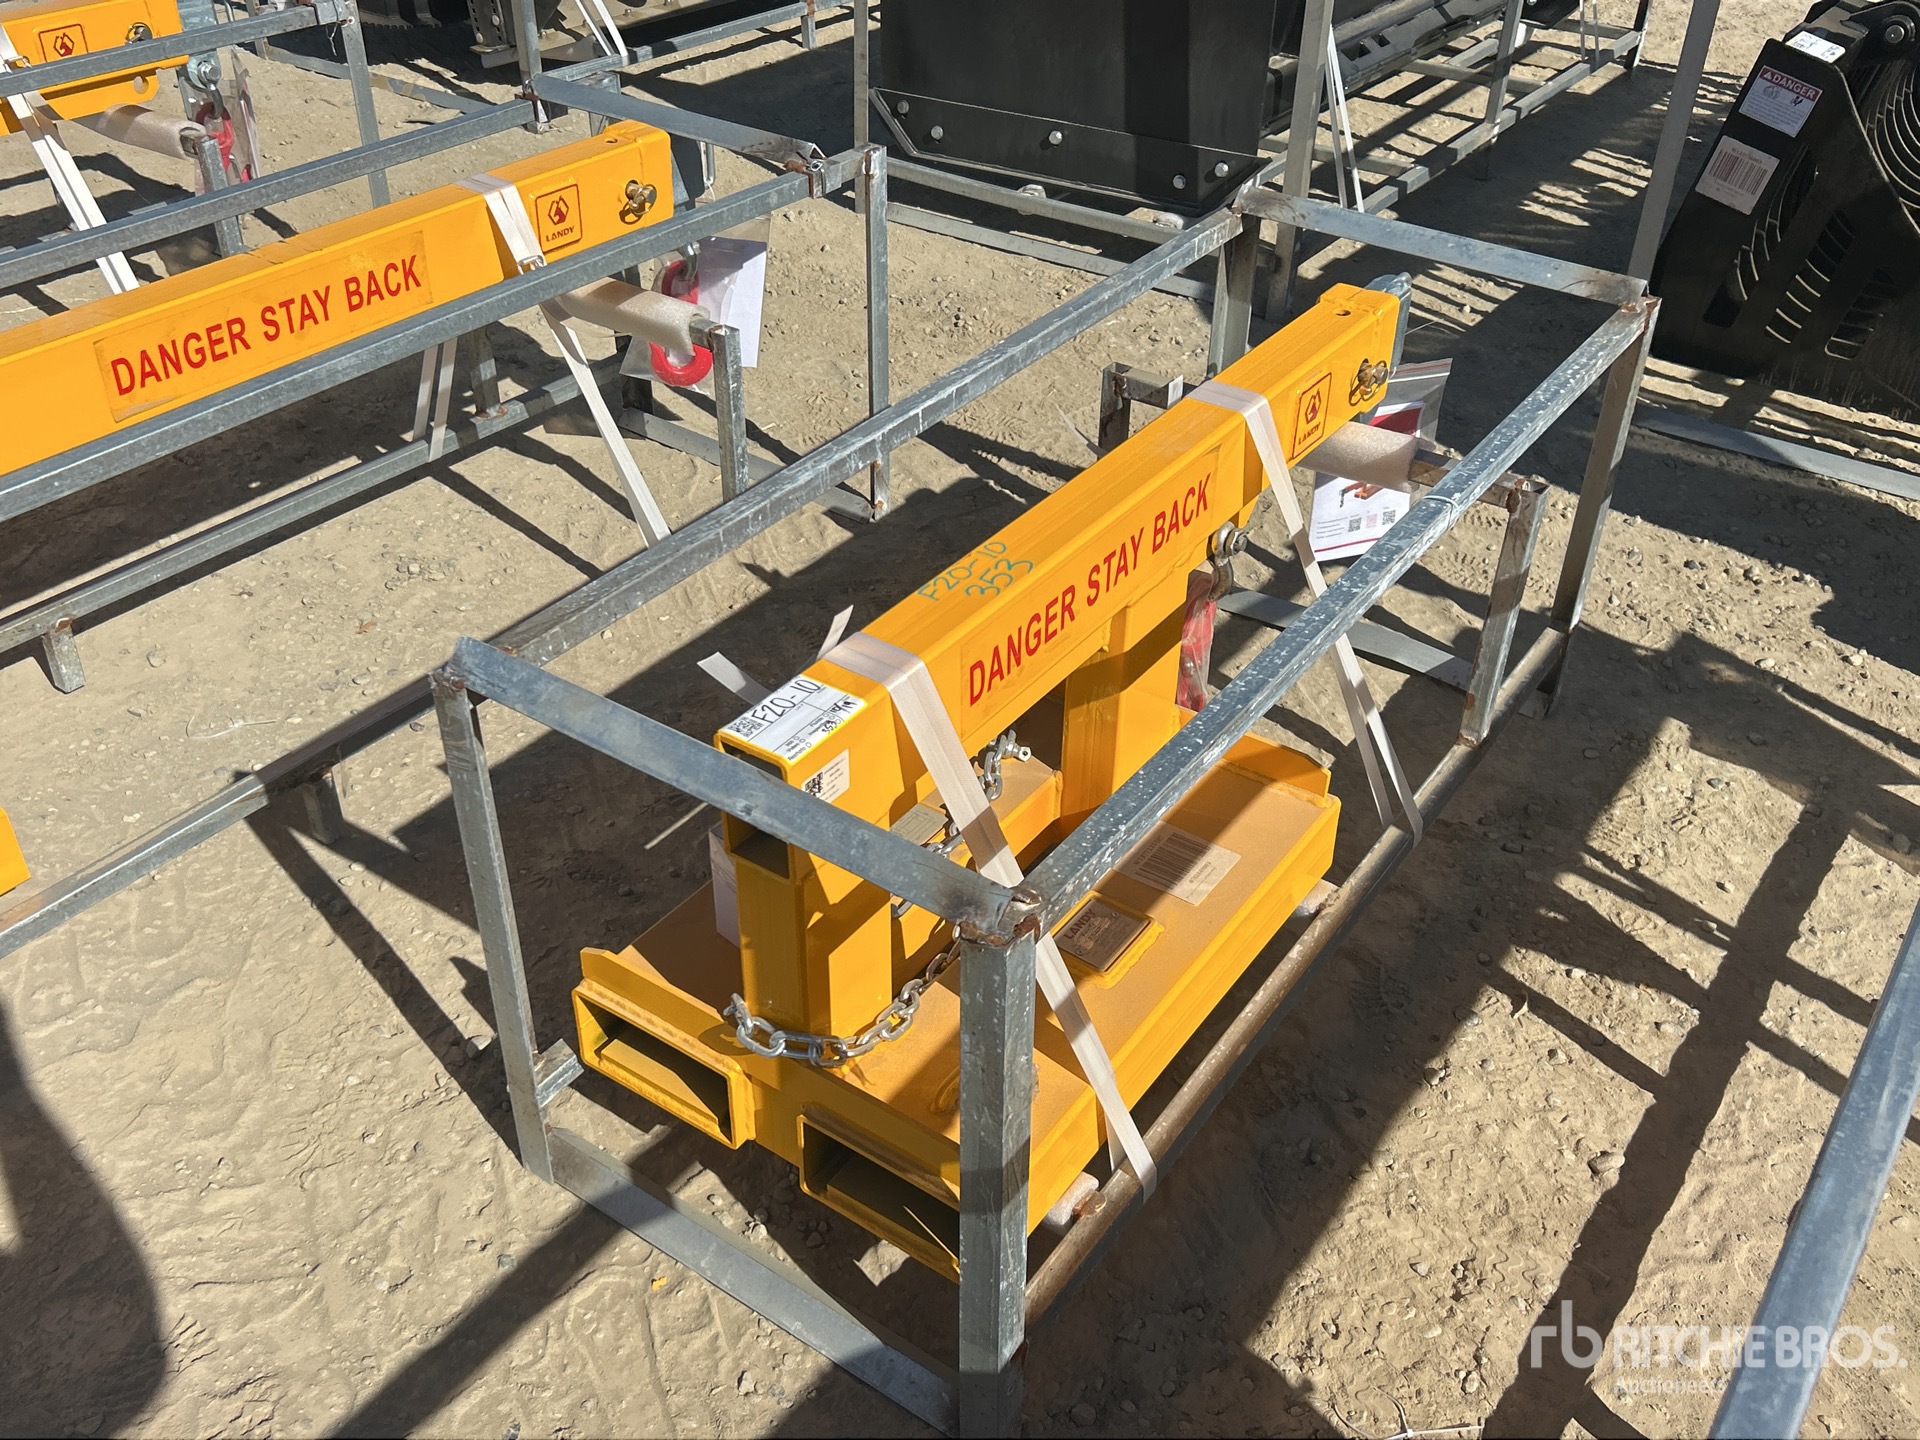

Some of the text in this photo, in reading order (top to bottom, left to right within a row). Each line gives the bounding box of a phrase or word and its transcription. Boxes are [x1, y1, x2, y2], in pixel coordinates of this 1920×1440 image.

[1771, 74, 1817, 100] DANGER
[545, 225, 575, 243] LANDY
[110, 254, 422, 396] DANGER STAY BACK
[917, 540, 1007, 602] F20-10
[964, 558, 1034, 598] 353
[969, 472, 1212, 707] DANGER STAY BACK
[1063, 908, 1097, 940] LANDY
